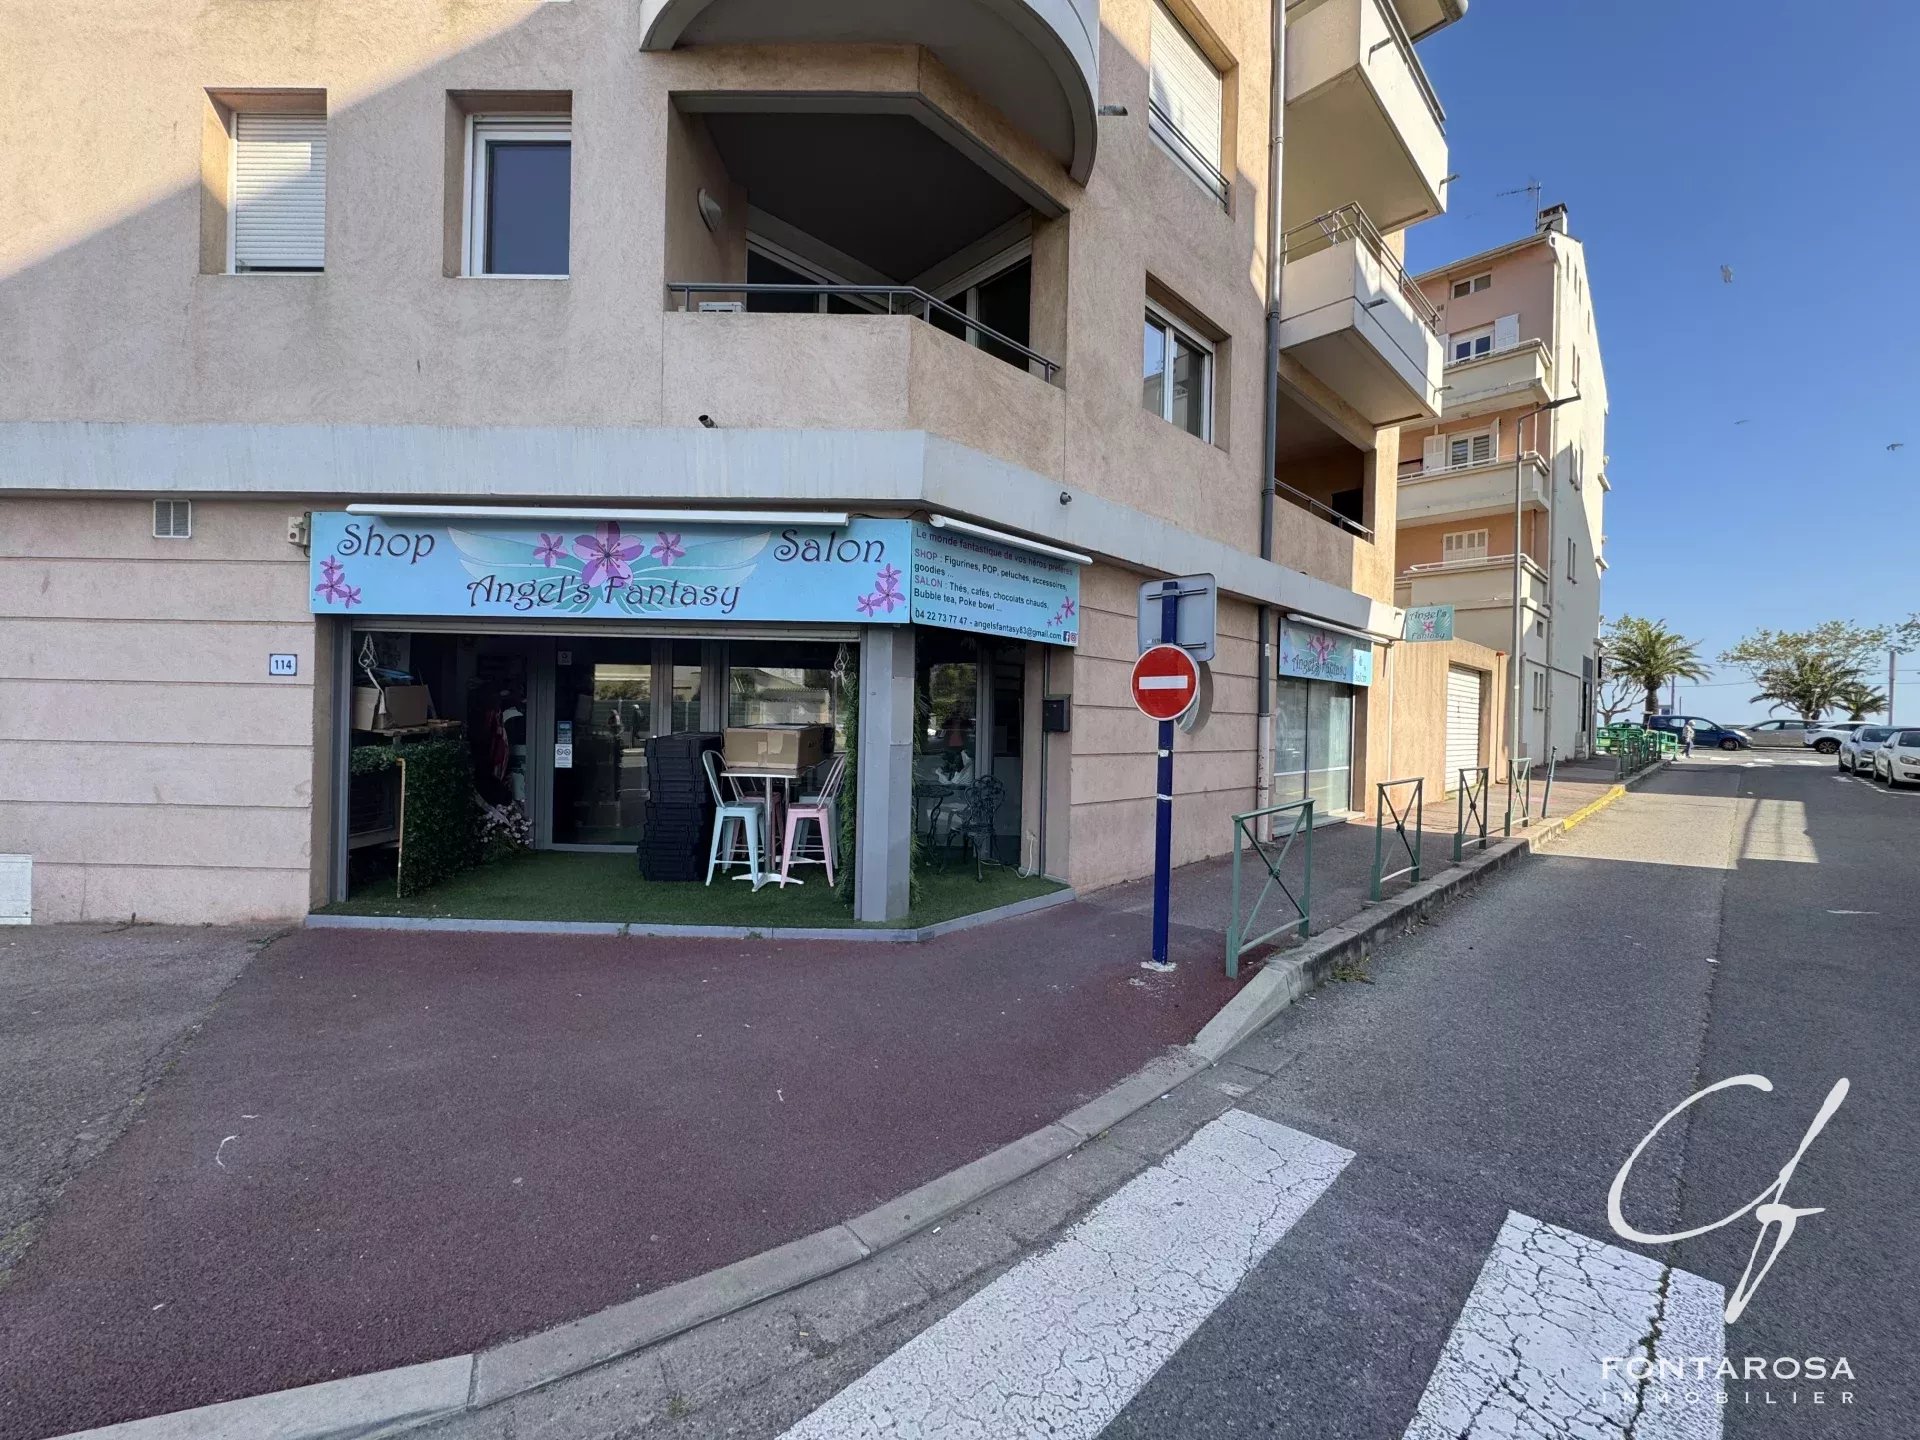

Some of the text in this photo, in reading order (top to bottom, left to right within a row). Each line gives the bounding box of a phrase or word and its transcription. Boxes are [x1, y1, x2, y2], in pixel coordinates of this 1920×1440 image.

[337, 523, 435, 565] Shop
[773, 528, 885, 563] Salon
[916, 527, 927, 539] Le
[929, 532, 958, 547] monde
[959, 539, 1002, 558] fantastique
[1003, 550, 1013, 561] de
[1015, 555, 1027, 565] vos
[914, 547, 938, 561] SHOP
[944, 555, 981, 572] Figurines,
[1000, 568, 1032, 584] peluches,
[1032, 576, 1068, 592] accessoires,
[914, 563, 946, 577] goodies
[466, 574, 741, 615] Angel's Fantasy
[913, 587, 942, 601] Bubble
[943, 594, 957, 605] tea,
[959, 596, 977, 608] Poke
[978, 600, 995, 611] bowl
[914, 574, 943, 589] SALON
[993, 591, 1025, 606] chocolats
[915, 609, 925, 619] 04
[926, 611, 936, 621] 22
[938, 613, 947, 622] 73
[949, 615, 958, 624] 77
[959, 616, 968, 626] 47
[274, 659, 292, 670] 114
